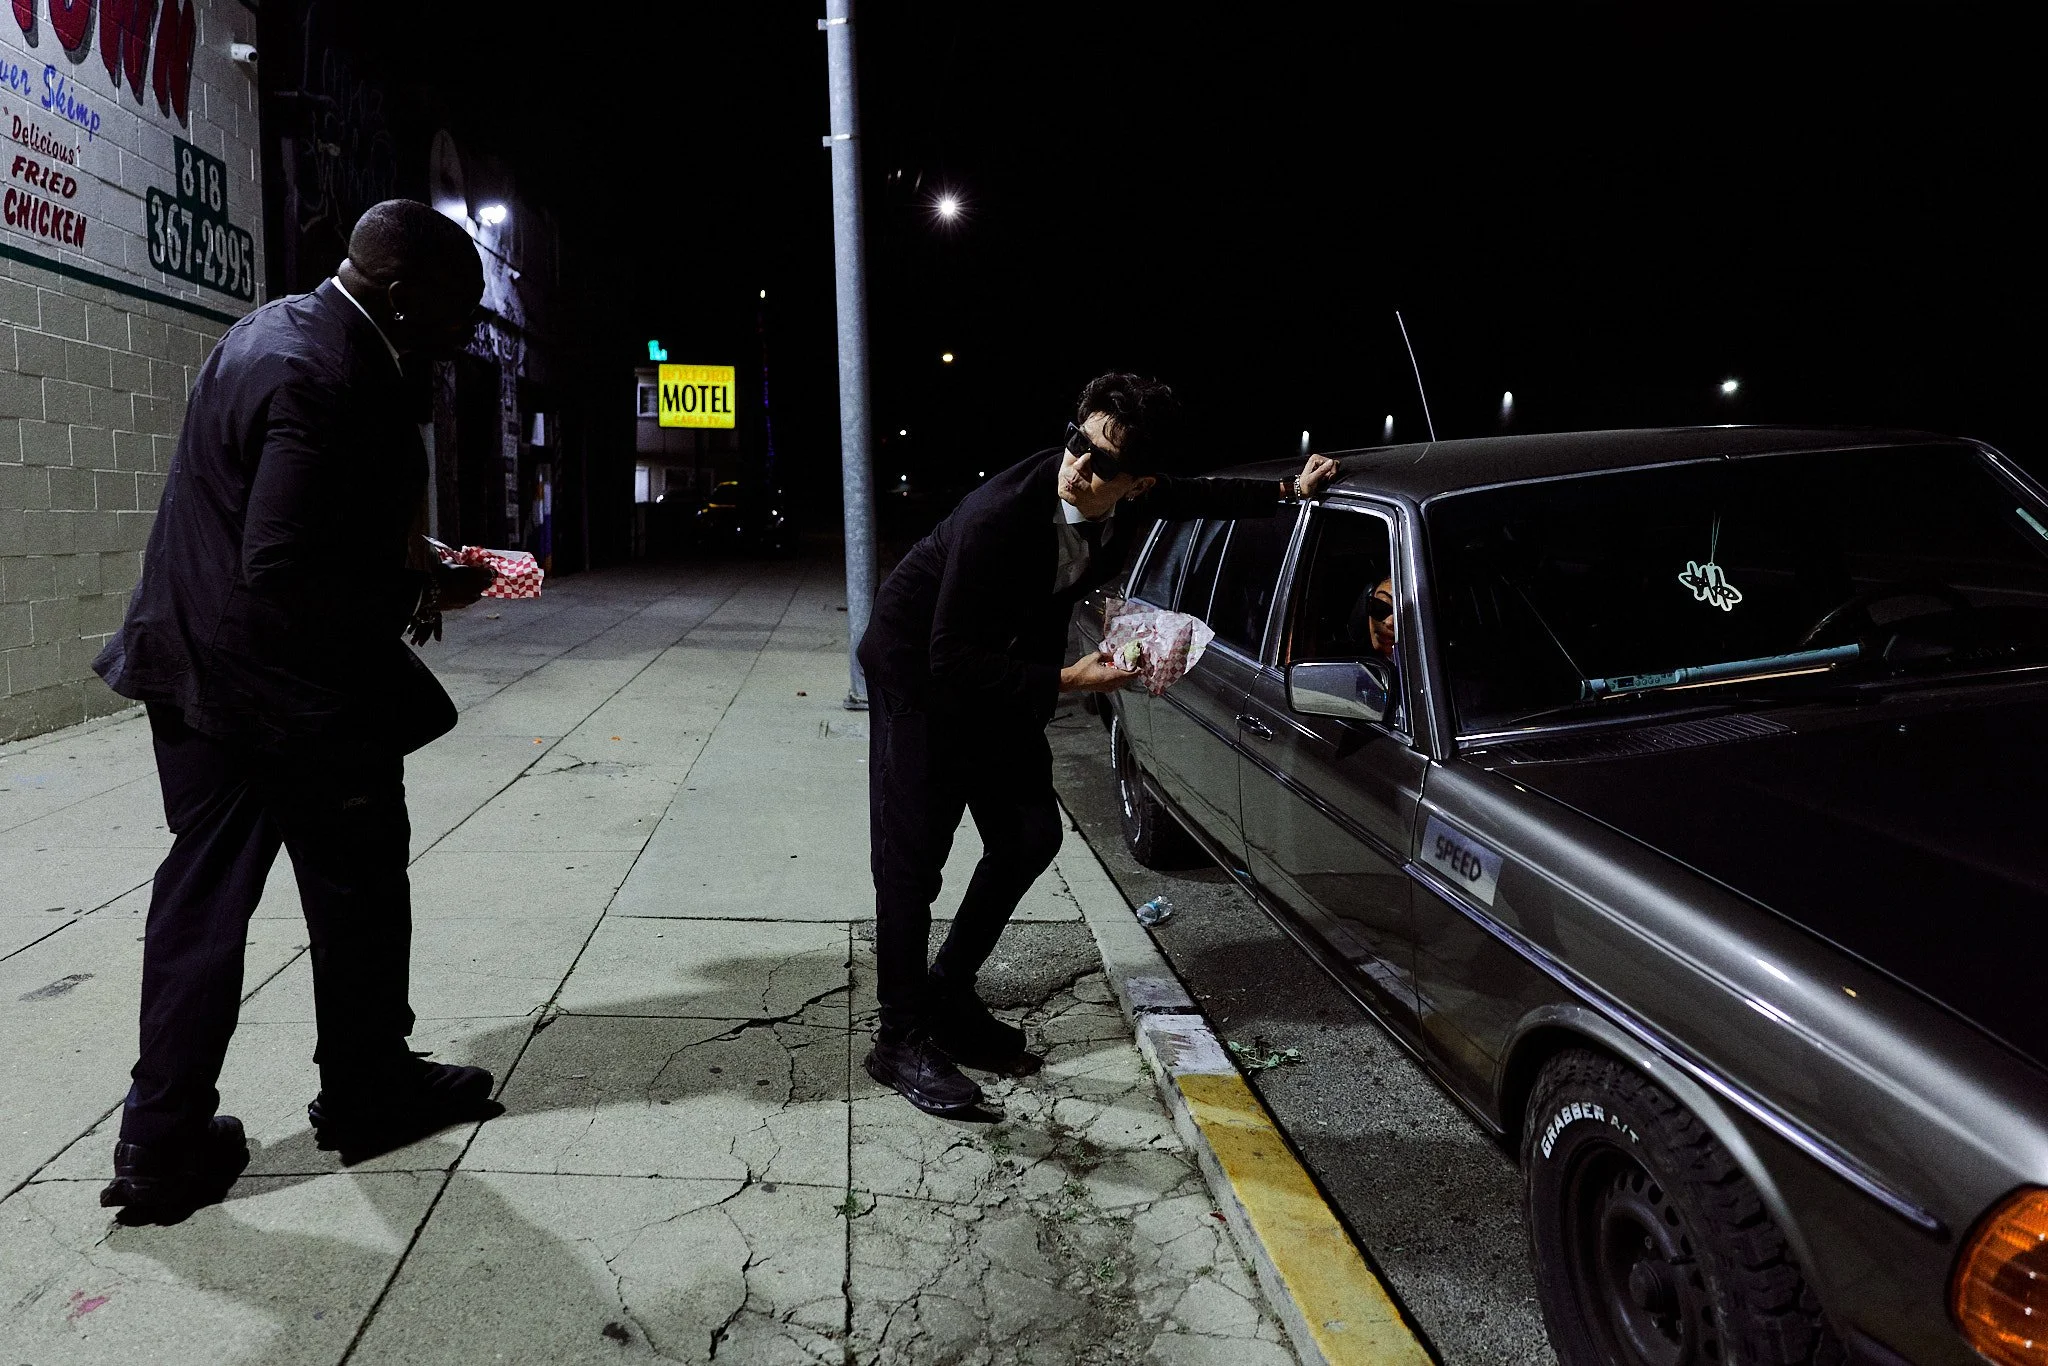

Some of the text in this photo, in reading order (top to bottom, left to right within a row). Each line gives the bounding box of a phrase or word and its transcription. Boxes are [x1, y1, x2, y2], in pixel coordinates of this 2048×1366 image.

[12, 0, 196, 129] WN
[41, 64, 100, 142] Skimp
[12, 155, 77, 199] FRIED
[182, 148, 221, 212] 818
[4, 188, 87, 249] CHICKEN
[662, 384, 732, 413] MOTEL
[1435, 834, 1482, 882] SPEED
[1541, 1102, 1605, 1160] GRABBER
